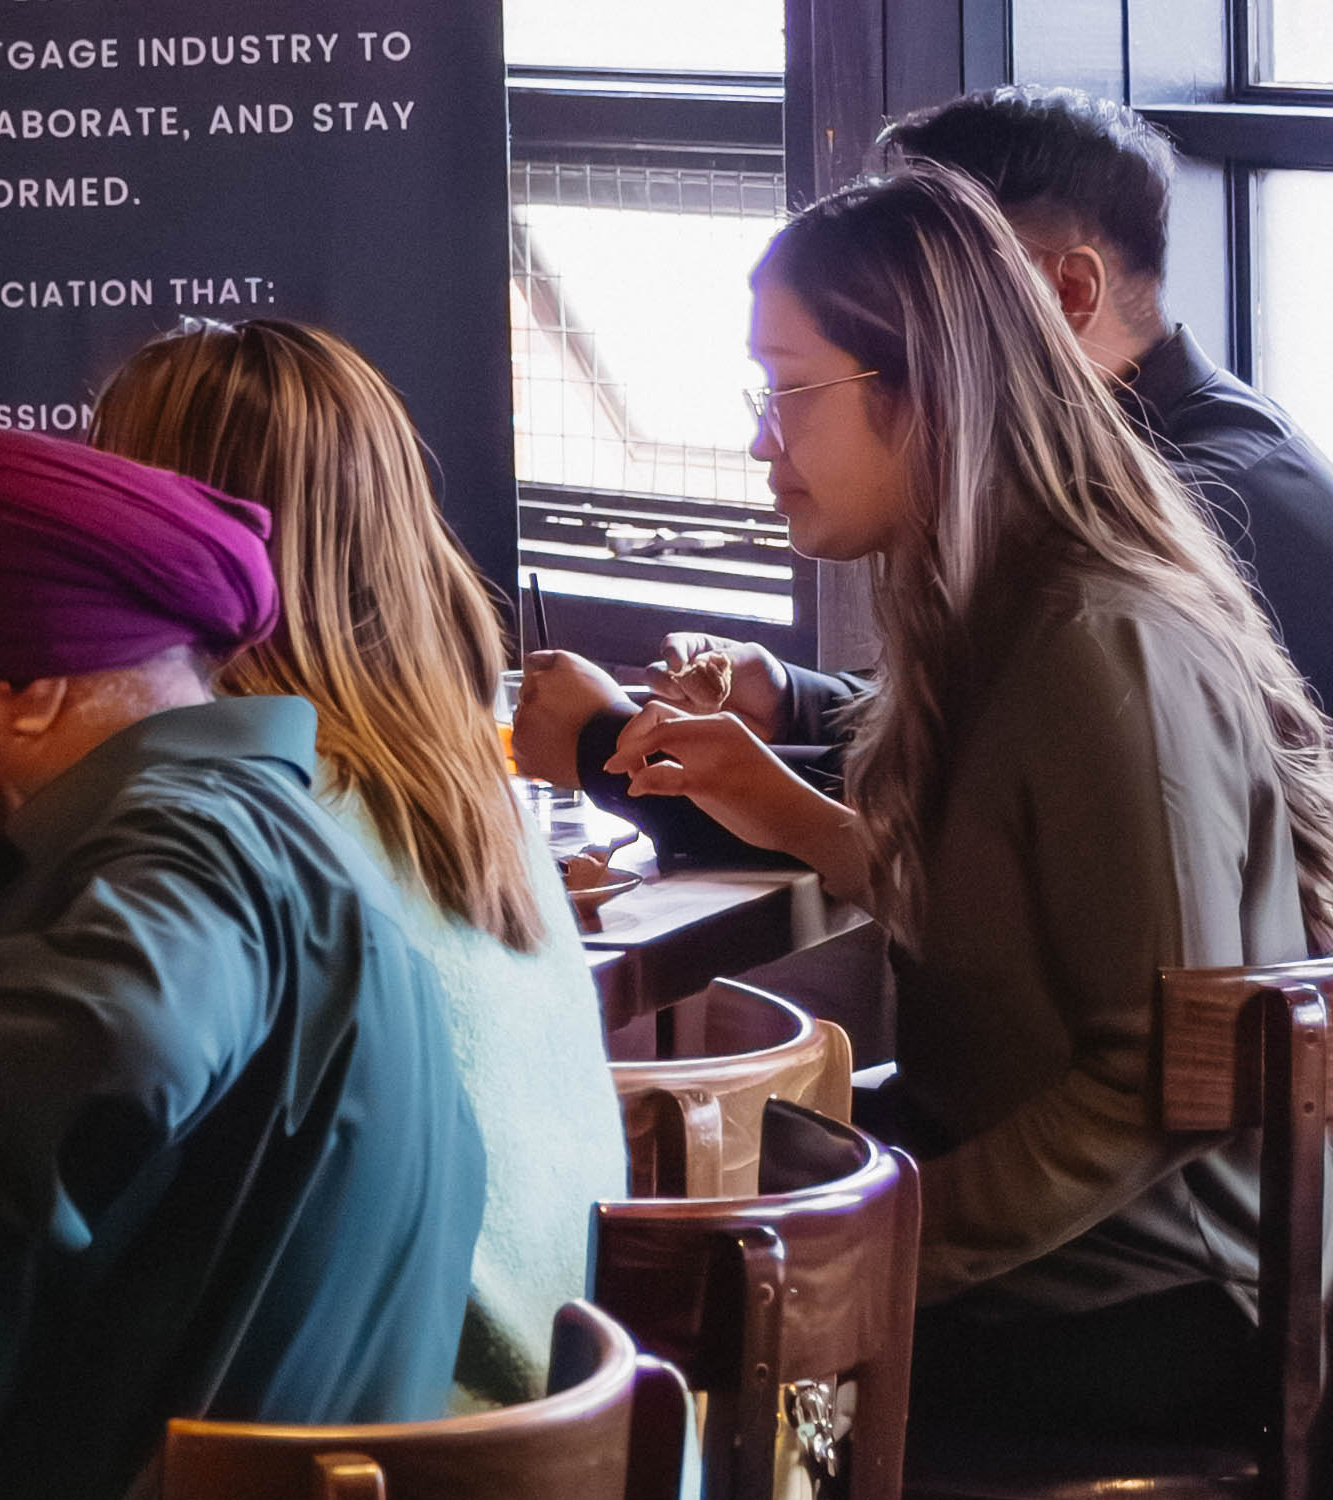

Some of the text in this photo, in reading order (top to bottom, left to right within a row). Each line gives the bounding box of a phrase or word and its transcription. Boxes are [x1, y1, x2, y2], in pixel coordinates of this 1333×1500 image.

[138, 33, 339, 67] INDUSTRY
[357, 31, 412, 62] TO
[209, 103, 294, 135] AND
[312, 100, 415, 133] STAY
[169, 277, 275, 305] THAT:
